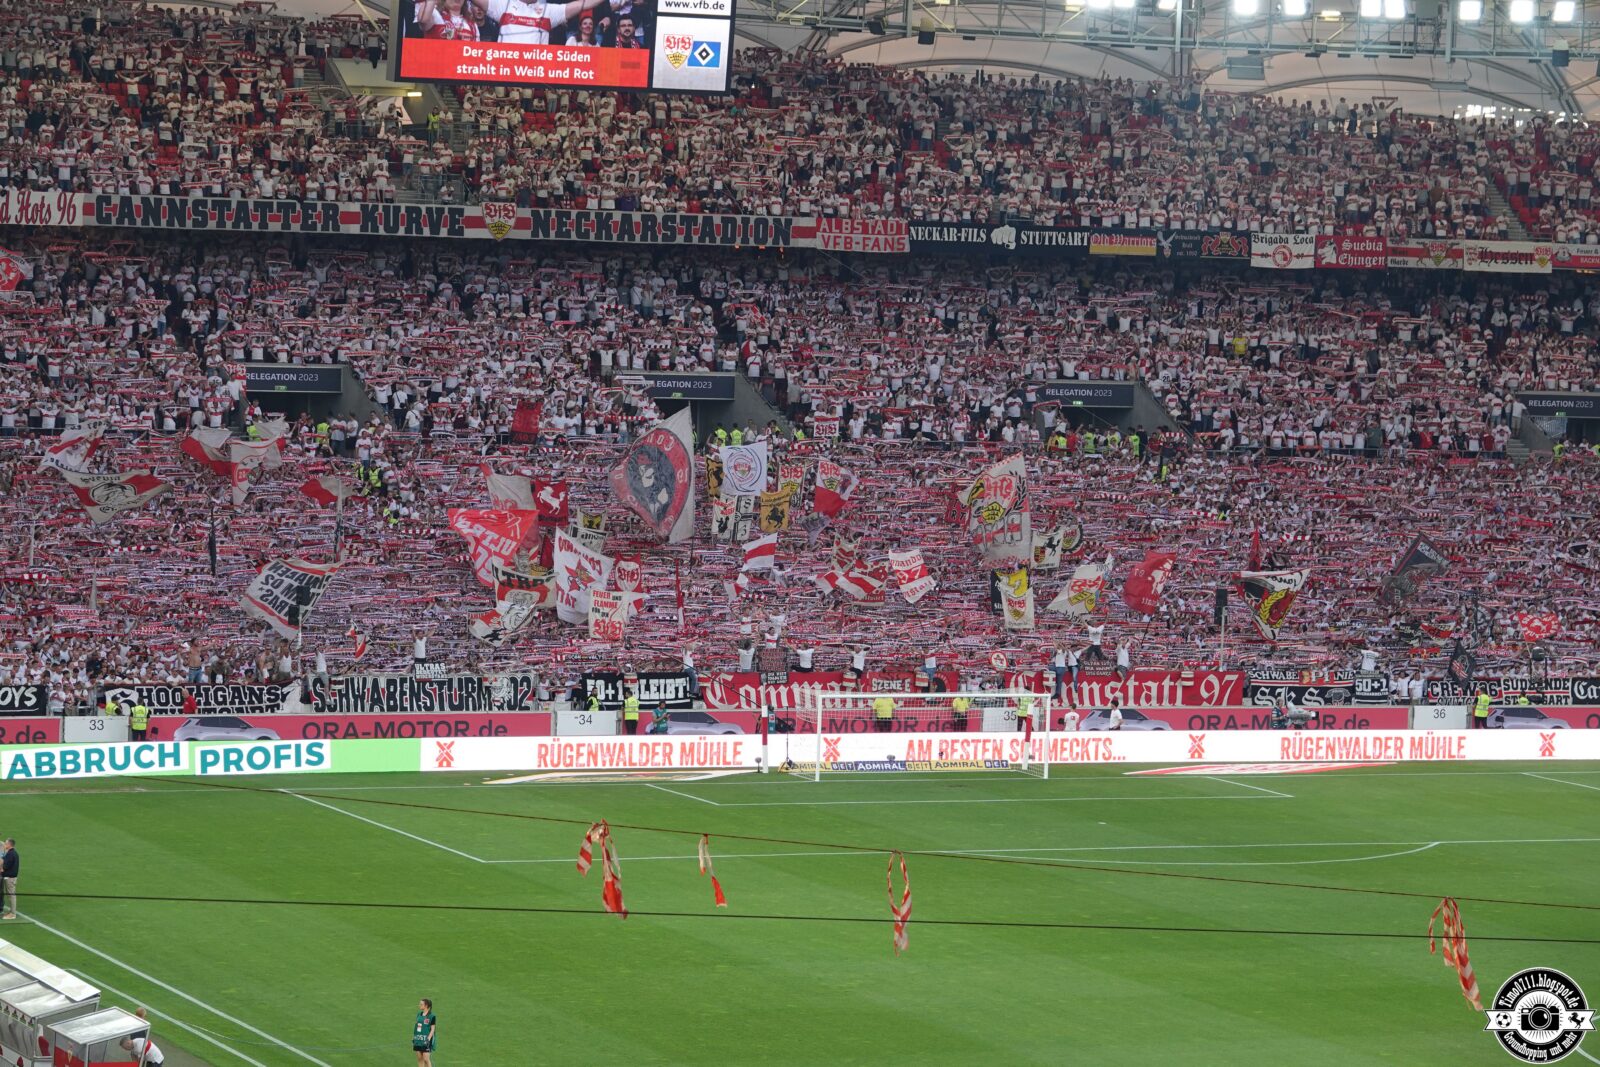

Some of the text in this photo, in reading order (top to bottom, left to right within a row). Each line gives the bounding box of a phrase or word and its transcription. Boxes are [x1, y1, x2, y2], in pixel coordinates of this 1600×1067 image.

[665, 1, 725, 10] www.vfb.de
[463, 46, 591, 62] Der ganze wilde Süden
[457, 64, 594, 79] strahlt in Weiß und Rot
[15, 191, 52, 224] Hots
[57, 192, 77, 225] 96
[95, 195, 464, 236] CANNSTATTER KURVE
[531, 209, 792, 246] NECKARSTADION
[819, 216, 909, 236] ALBSTADT
[821, 234, 907, 251] VFB-FANS
[910, 226, 1089, 246] NECKAR-FILS STUTTGART
[1111, 234, 1157, 248] Warriors
[1252, 234, 1314, 246] Brigada Loca
[1342, 239, 1383, 251] Suebia
[246, 372, 319, 381] RELEGATION 2023
[655, 380, 712, 389] EGATION 2023
[1046, 388, 1113, 397] RELEGATION 2023
[1528, 399, 1594, 408] RELEGATION 2023
[414, 663, 446, 671] ULTRAS
[872, 678, 903, 692] SZENE
[1200, 674, 1239, 707] 97
[1355, 679, 1389, 692] 50+1
[578, 714, 593, 726] 34
[1003, 711, 1017, 721] 35
[1433, 708, 1446, 719] 36
[89, 719, 104, 731] 33
[302, 720, 508, 739] ORA-MOTOR.de
[537, 736, 743, 768] RÜGENWALDER MÜHLE
[906, 738, 932, 762] AM
[939, 738, 1004, 762] BESTEN
[1280, 731, 1466, 761] RÜGENWALDER MÜHLE
[7, 741, 325, 779] ABBRUCH PROFIS
[857, 762, 904, 771] ADMIRAL
[935, 760, 984, 769] ADMIRAL
